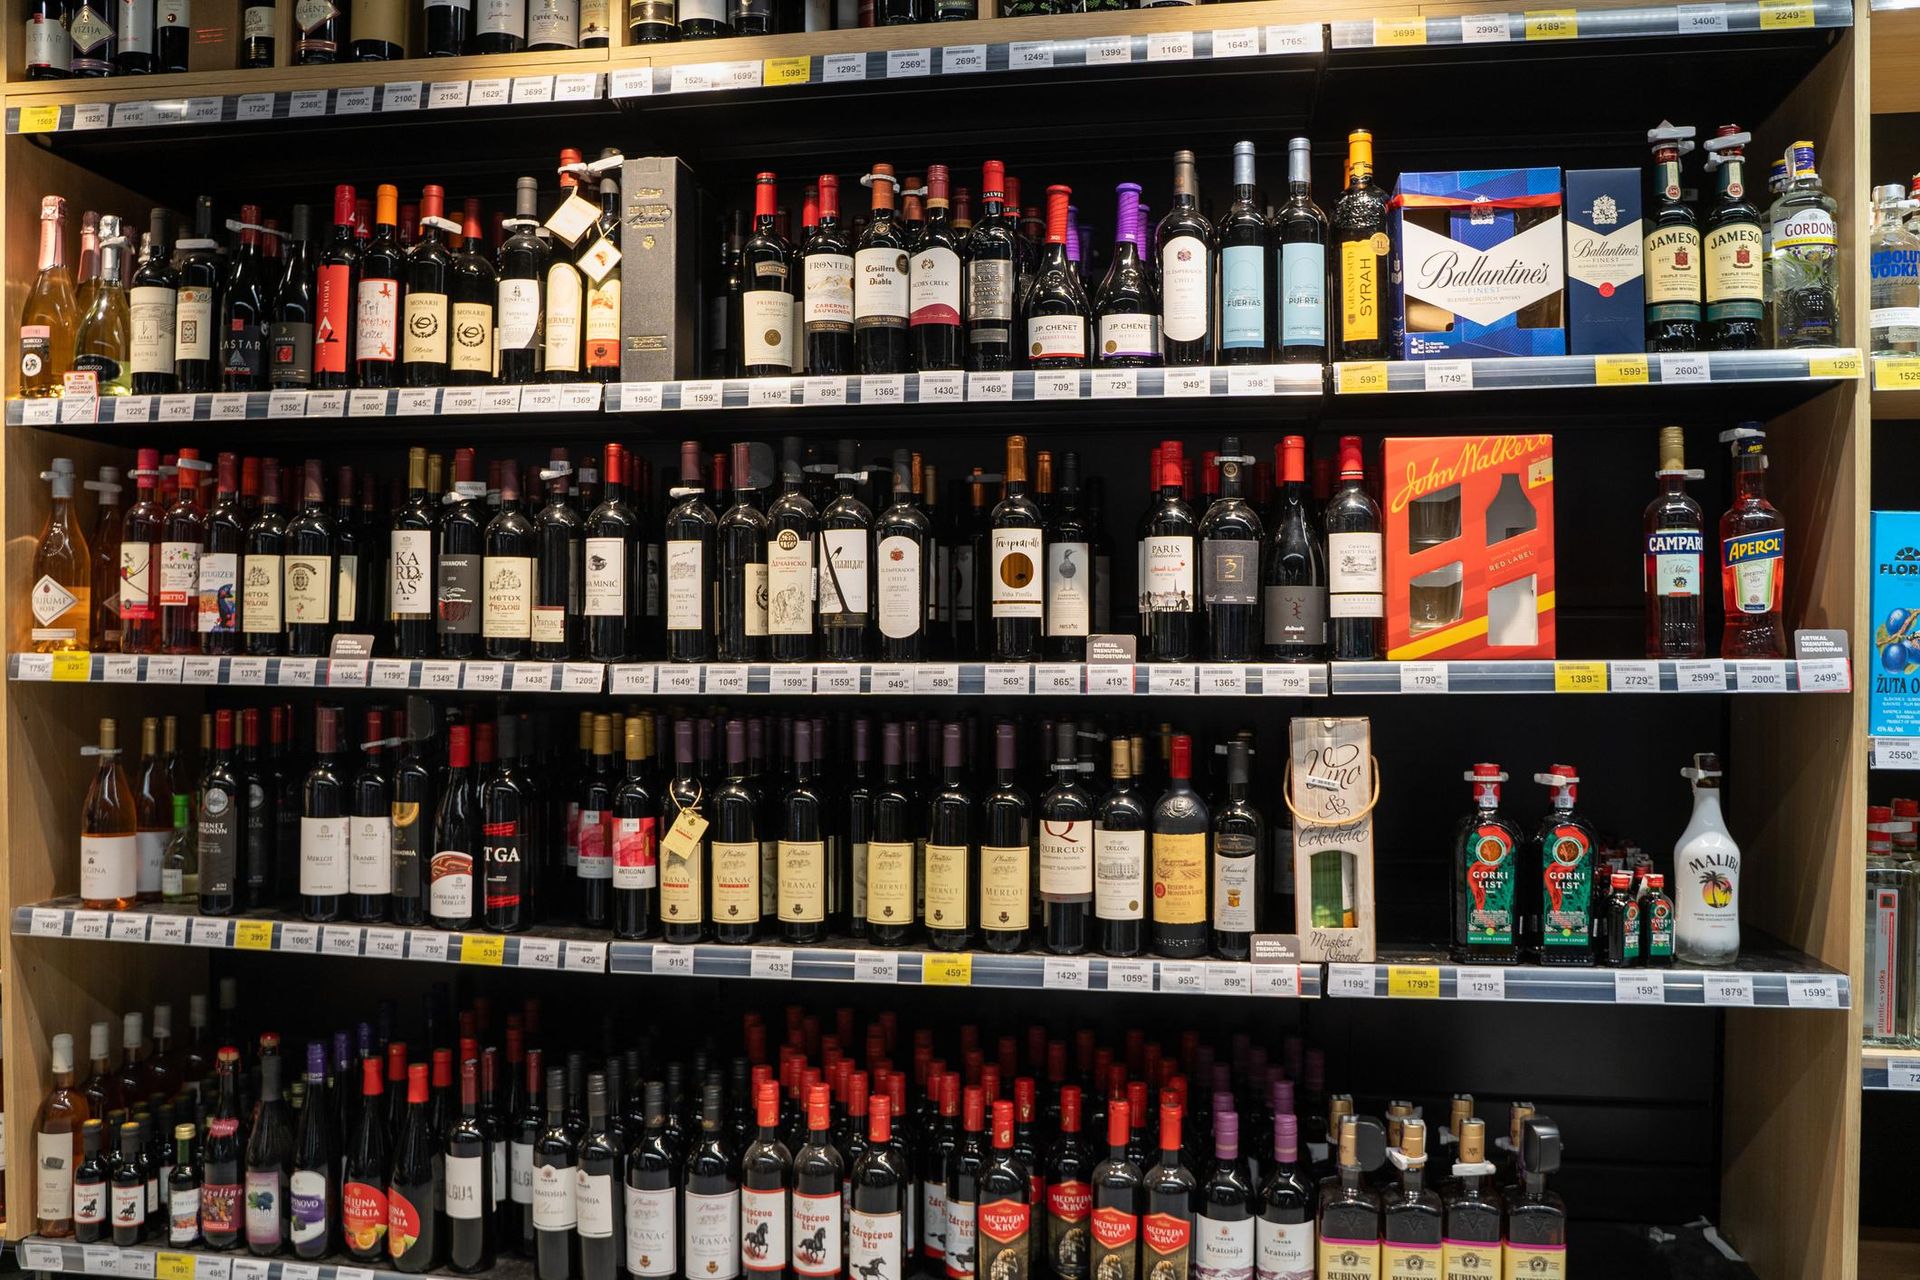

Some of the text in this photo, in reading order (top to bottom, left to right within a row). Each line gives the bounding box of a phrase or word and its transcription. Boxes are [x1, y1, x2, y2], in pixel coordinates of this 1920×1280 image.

[1710, 231, 1762, 250] JAMESO
[1572, 239, 1639, 258] Ballantine's
[866, 264, 895, 273] Casillero
[1418, 251, 1549, 289] Ballantine's
[1871, 263, 1918, 279] VODKA
[869, 278, 892, 286] Diablo
[1360, 257, 1372, 316] SYRAH
[1046, 324, 1078, 332] CHENET
[1120, 322, 1153, 331] CHENET
[1391, 457, 1454, 513] John
[1649, 536, 1703, 552] CAMPARI
[1729, 538, 1780, 560] APEROL
[1152, 545, 1180, 556] PARIS
[396, 552, 420, 566] KA
[1489, 550, 1533, 572] RED LABEL
[1880, 564, 1920, 575] FLOR
[396, 581, 417, 594] AS
[1876, 675, 1906, 693] ŽUTA
[1041, 845, 1086, 854] QUERCUS
[717, 876, 753, 884] VRANAC
[1473, 871, 1509, 880] GORKI
[1550, 872, 1585, 880] GORKI
[782, 880, 818, 889] VRANAC
[1479, 881, 1503, 889] LIST
[1556, 881, 1580, 890] LIST
[985, 887, 1023, 896] MERLOT
[1310, 932, 1352, 949] Muskat
[1328, 1272, 1371, 1280] RUBINOV
